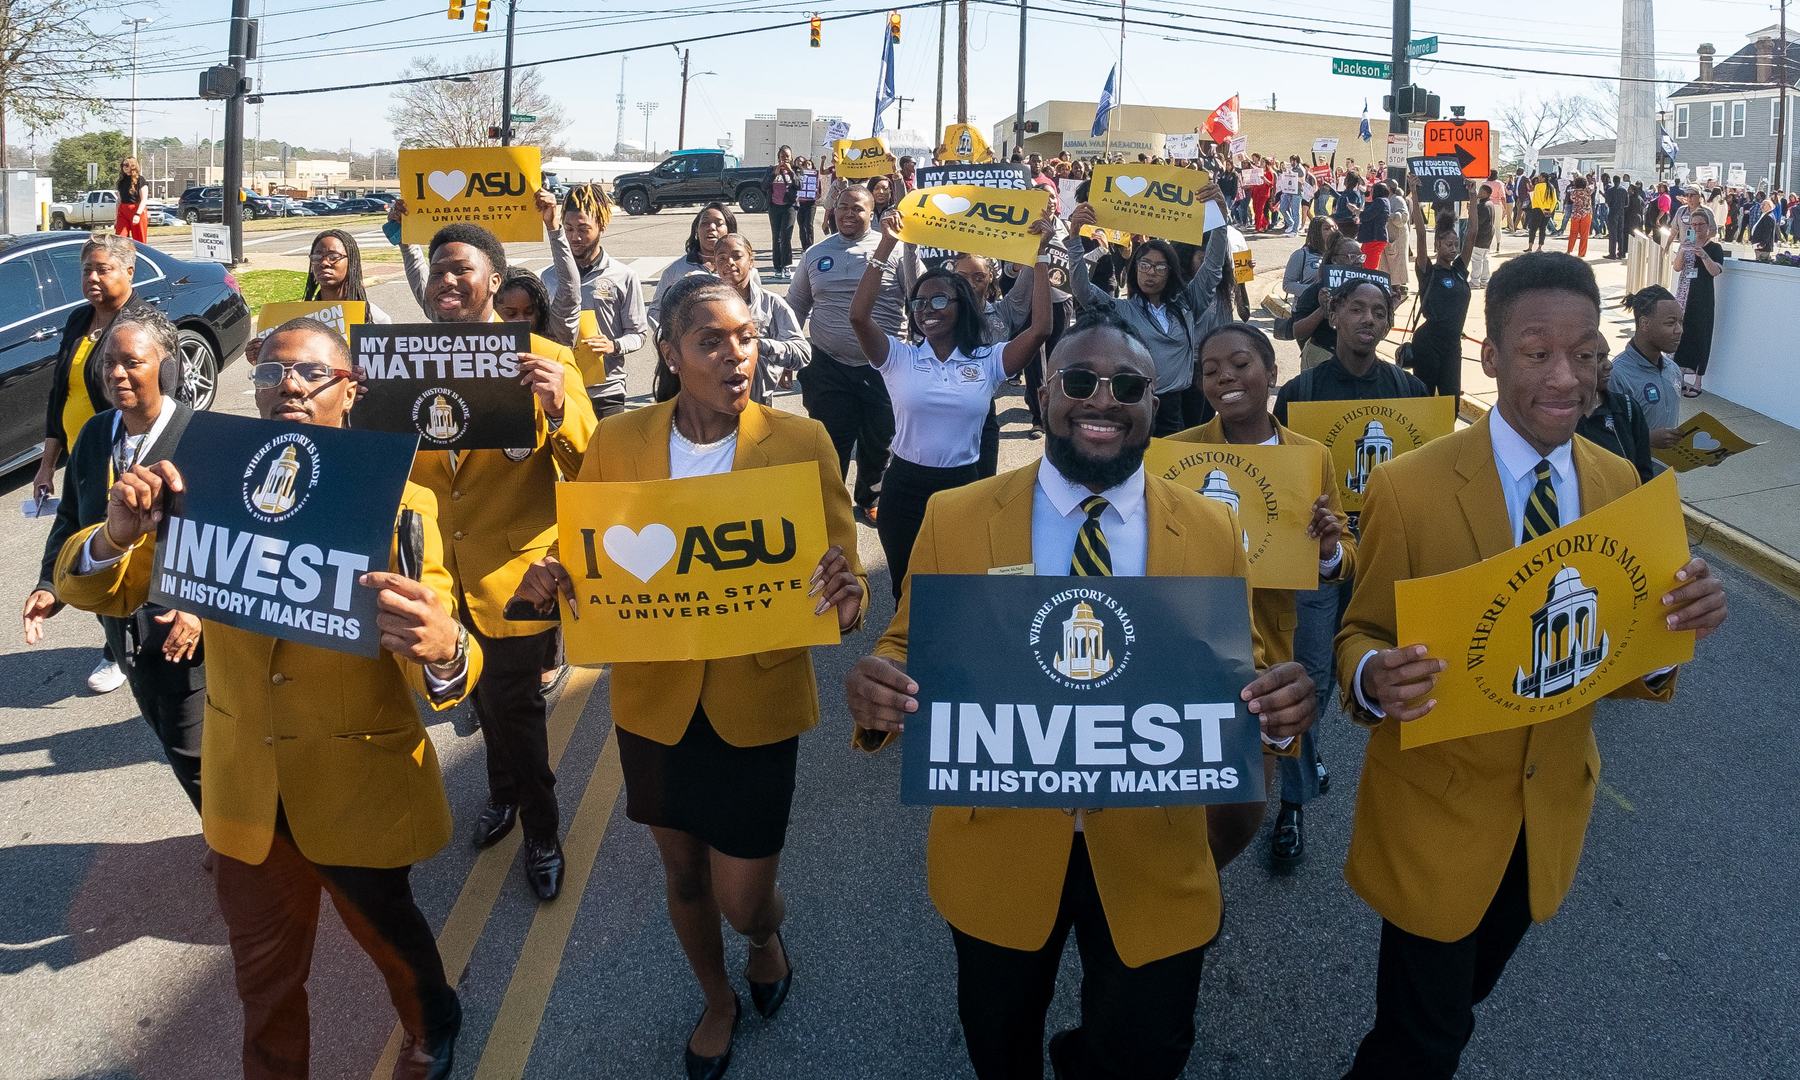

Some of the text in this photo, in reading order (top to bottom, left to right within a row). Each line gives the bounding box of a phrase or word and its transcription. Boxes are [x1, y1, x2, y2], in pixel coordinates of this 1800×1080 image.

[1338, 61, 1380, 76] Jackson
[1430, 128, 1482, 142] DETOUR
[860, 147, 884, 159] ASU
[416, 172, 526, 200] I ASU
[926, 170, 1023, 180] MY EDUCATION
[1414, 167, 1461, 176] MATTERS
[1104, 176, 1194, 206] I ASU
[917, 194, 1030, 226] I ASU
[1102, 198, 1192, 218] ALABAMA STATE
[1114, 206, 1179, 222] UNIVERSITY
[912, 212, 1024, 238] ALABAMA STATE
[926, 220, 1008, 240] UNIVERSITY
[360, 336, 516, 352] MY EDUCATION
[359, 353, 520, 380] MATTERS
[412, 396, 426, 421] WHERE
[422, 387, 452, 399] HISTORY
[452, 392, 459, 400] IS
[1324, 421, 1344, 448] HERE
[1343, 406, 1396, 424] HISTORY
[1396, 413, 1408, 425] IS
[244, 433, 320, 488] WHERE HISTORY IS MADE.
[243, 482, 310, 522] ALABAMA STATE UNIVERSITY
[1179, 451, 1278, 524] HISTORY IS MADE.
[580, 516, 796, 579] I ASU
[1249, 531, 1272, 564] ERSITY
[164, 516, 370, 612] INVEST
[590, 578, 802, 604] ALABAMA STATE
[1467, 534, 1649, 672] WHERE HISTORY IS MADE.
[161, 573, 360, 640] IN HISTORY MAKERS
[618, 598, 772, 620] UNIVERSITY
[1030, 588, 1136, 646] WHERE HISTORY IS MADE.
[1034, 650, 1132, 690] ALABAMA STATE UNIVERSITY
[1474, 618, 1639, 712] ALABAMA STATE UNIVERSITY
[930, 702, 1236, 766] INVEST
[928, 768, 1239, 793] IN HISTORY MAKERS
